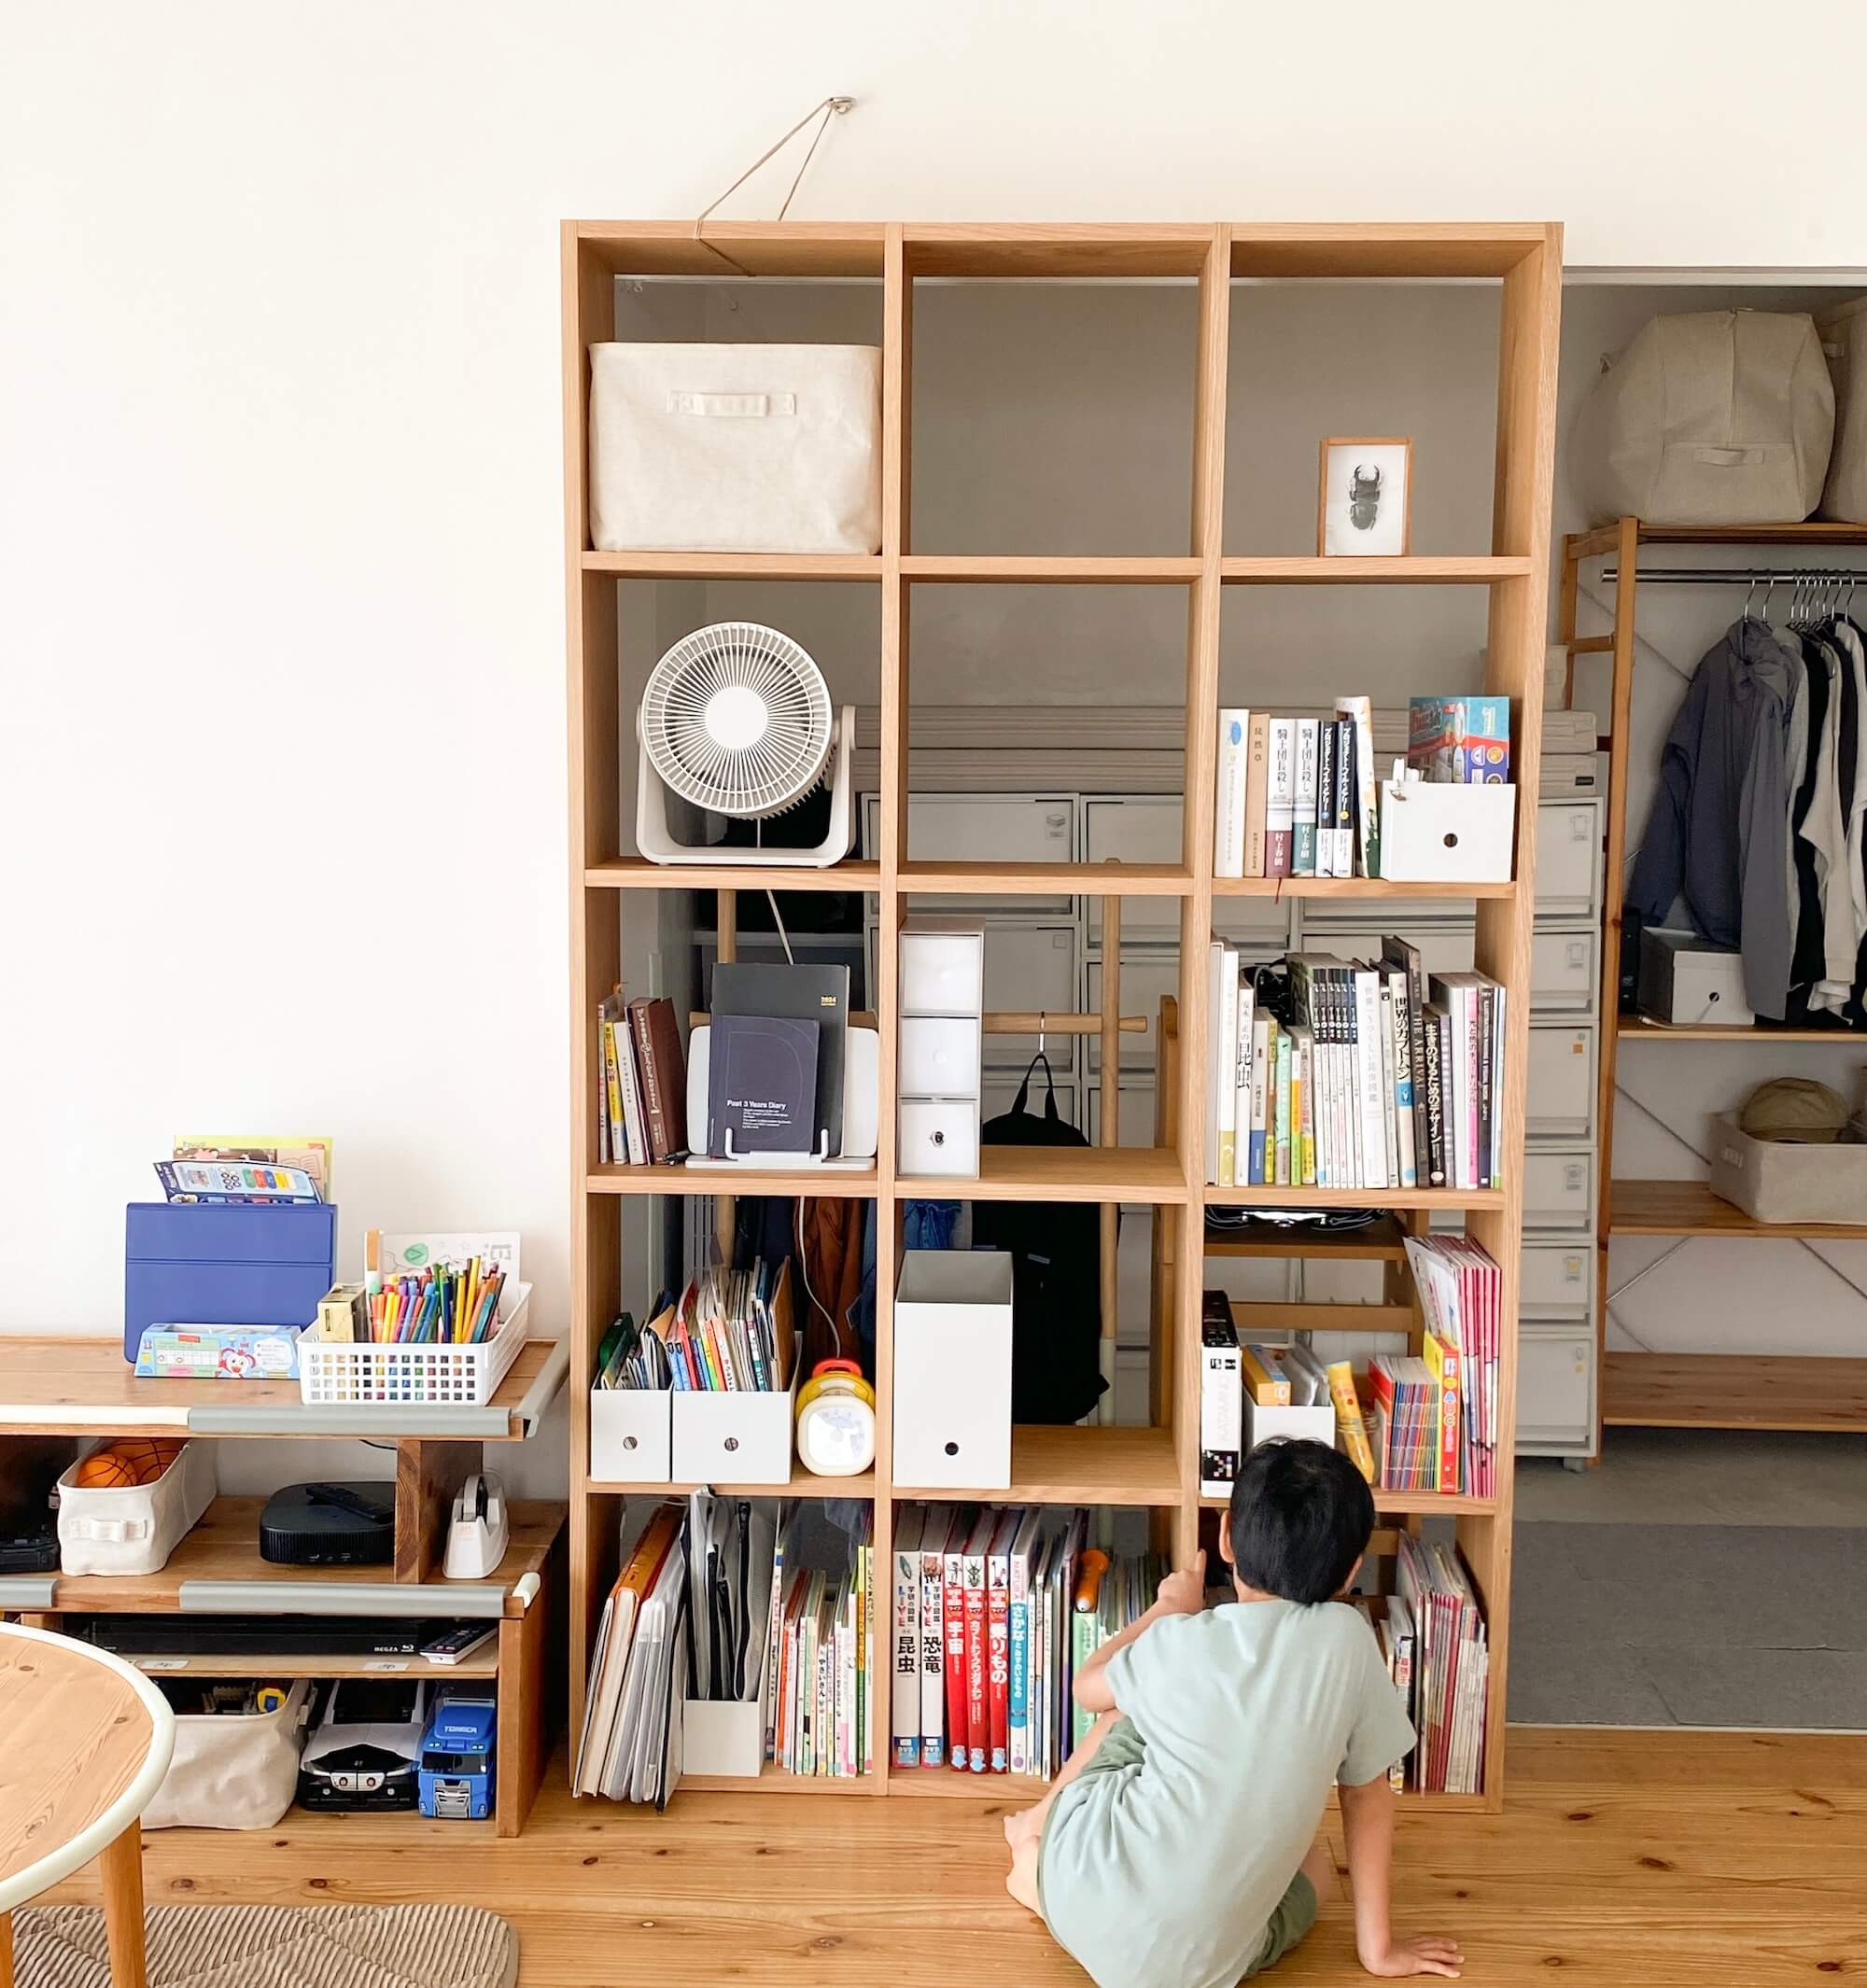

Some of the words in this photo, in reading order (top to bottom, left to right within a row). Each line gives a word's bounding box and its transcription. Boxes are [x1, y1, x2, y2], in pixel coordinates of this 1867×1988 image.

[1277, 728, 1288, 792] 騎士団長殺し
[1301, 728, 1313, 792] 騎士団長殺し
[1274, 833, 1284, 867] 村上春樹
[1300, 825, 1311, 860] 村上春樹
[1413, 1010, 1424, 1034] THE
[1414, 1038, 1426, 1091] ARRIVAL
[768, 1101, 787, 1111] Diary
[897, 1586, 906, 1627] LIVE
[923, 1586, 932, 1627] LIVE
[897, 1636, 916, 1673] 昆虫
[923, 1636, 942, 1673] 恐竜
[948, 1620, 964, 1655] 宇宙
[990, 1622, 1008, 1685] 乗りもの
[444, 1725, 478, 1734] TOMICA
